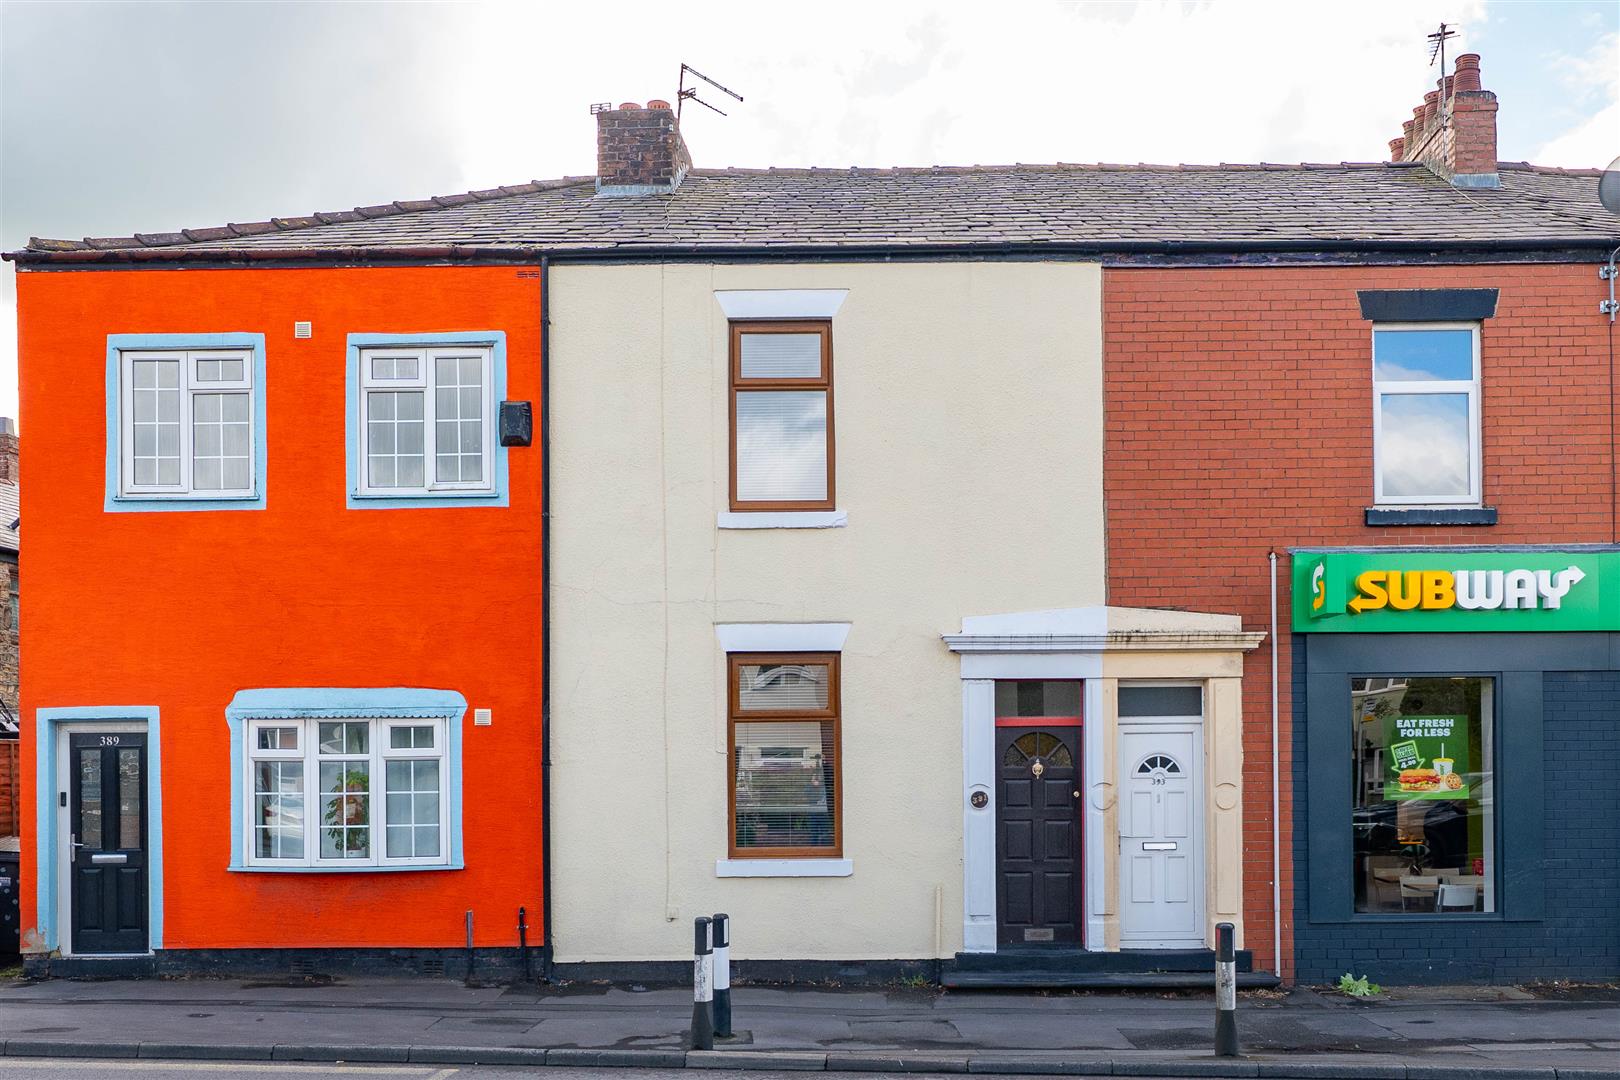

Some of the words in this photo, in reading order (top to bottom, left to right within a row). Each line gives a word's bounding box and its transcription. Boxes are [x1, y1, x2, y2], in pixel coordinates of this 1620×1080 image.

[1348, 565, 1587, 614] SUBWAY
[1396, 719, 1417, 728] EAT
[1418, 718, 1454, 728] FRESH
[1400, 728, 1423, 737] FOR
[1424, 728, 1451, 737] LESS
[100, 736, 120, 746] 389
[1151, 778, 1166, 786] 393
